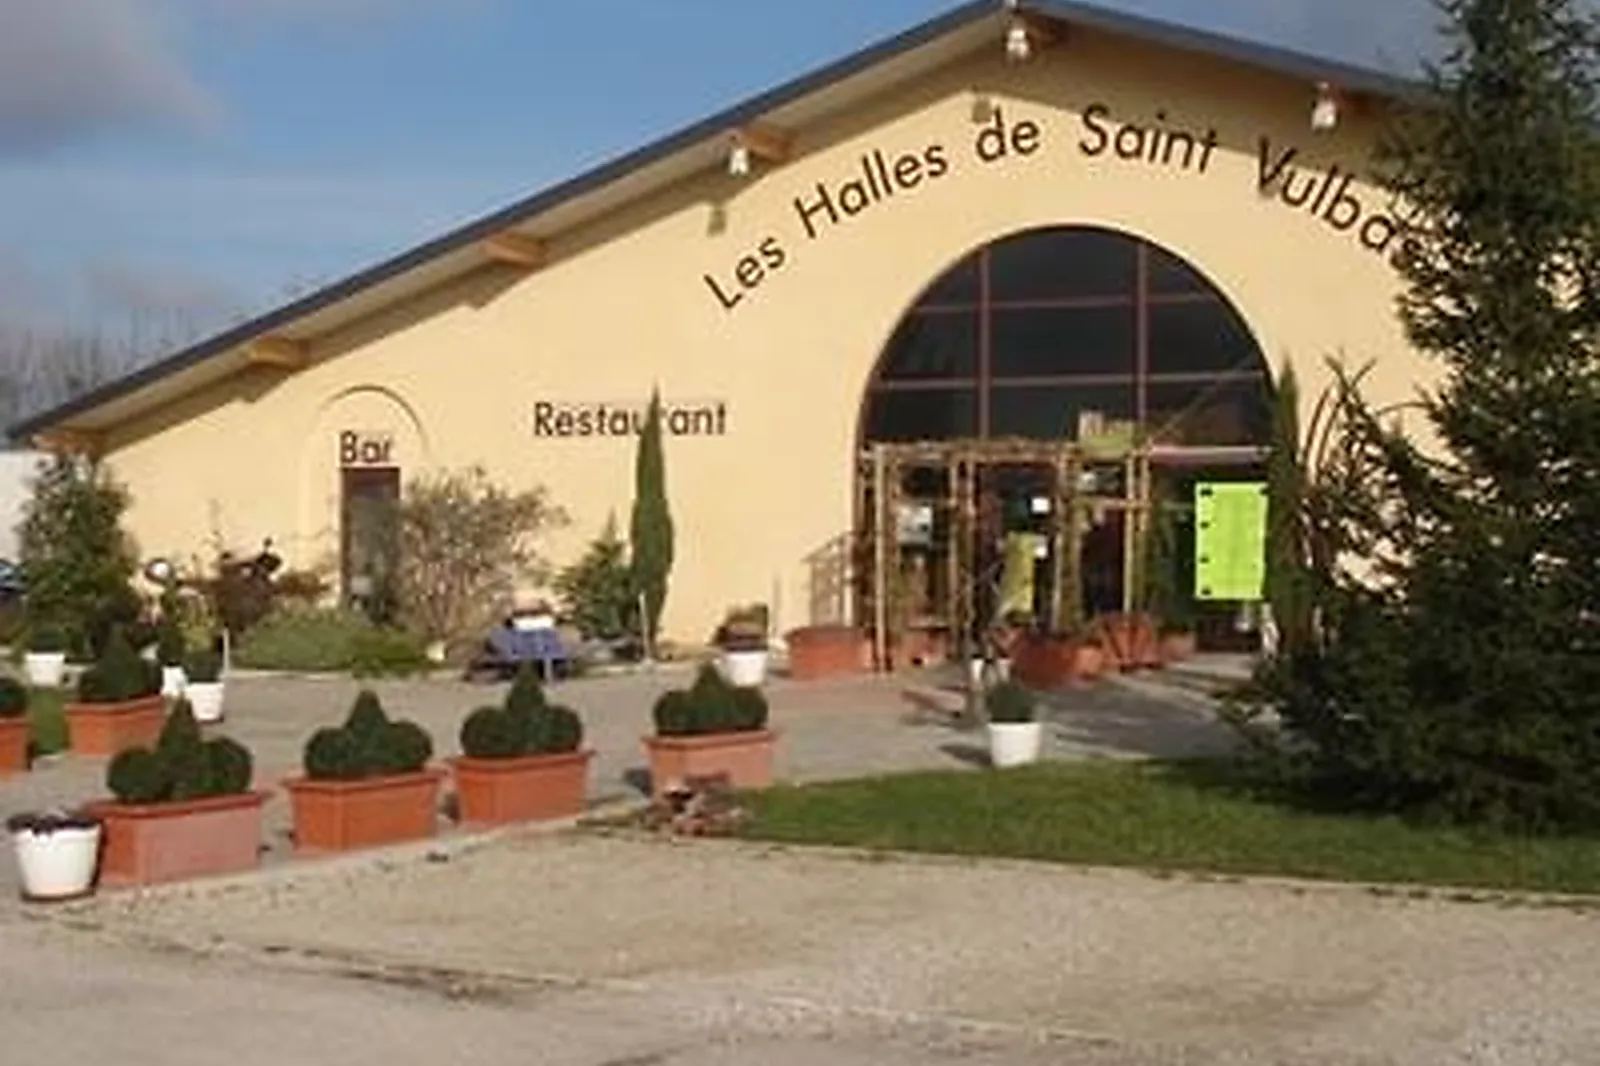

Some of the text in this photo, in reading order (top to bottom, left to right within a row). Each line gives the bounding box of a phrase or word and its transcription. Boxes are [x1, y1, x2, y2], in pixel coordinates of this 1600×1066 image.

[703, 236, 785, 310] Les
[793, 144, 948, 238] Halles
[975, 105, 1040, 163] de
[1079, 104, 1217, 174] Saint
[340, 430, 393, 463] Bar
